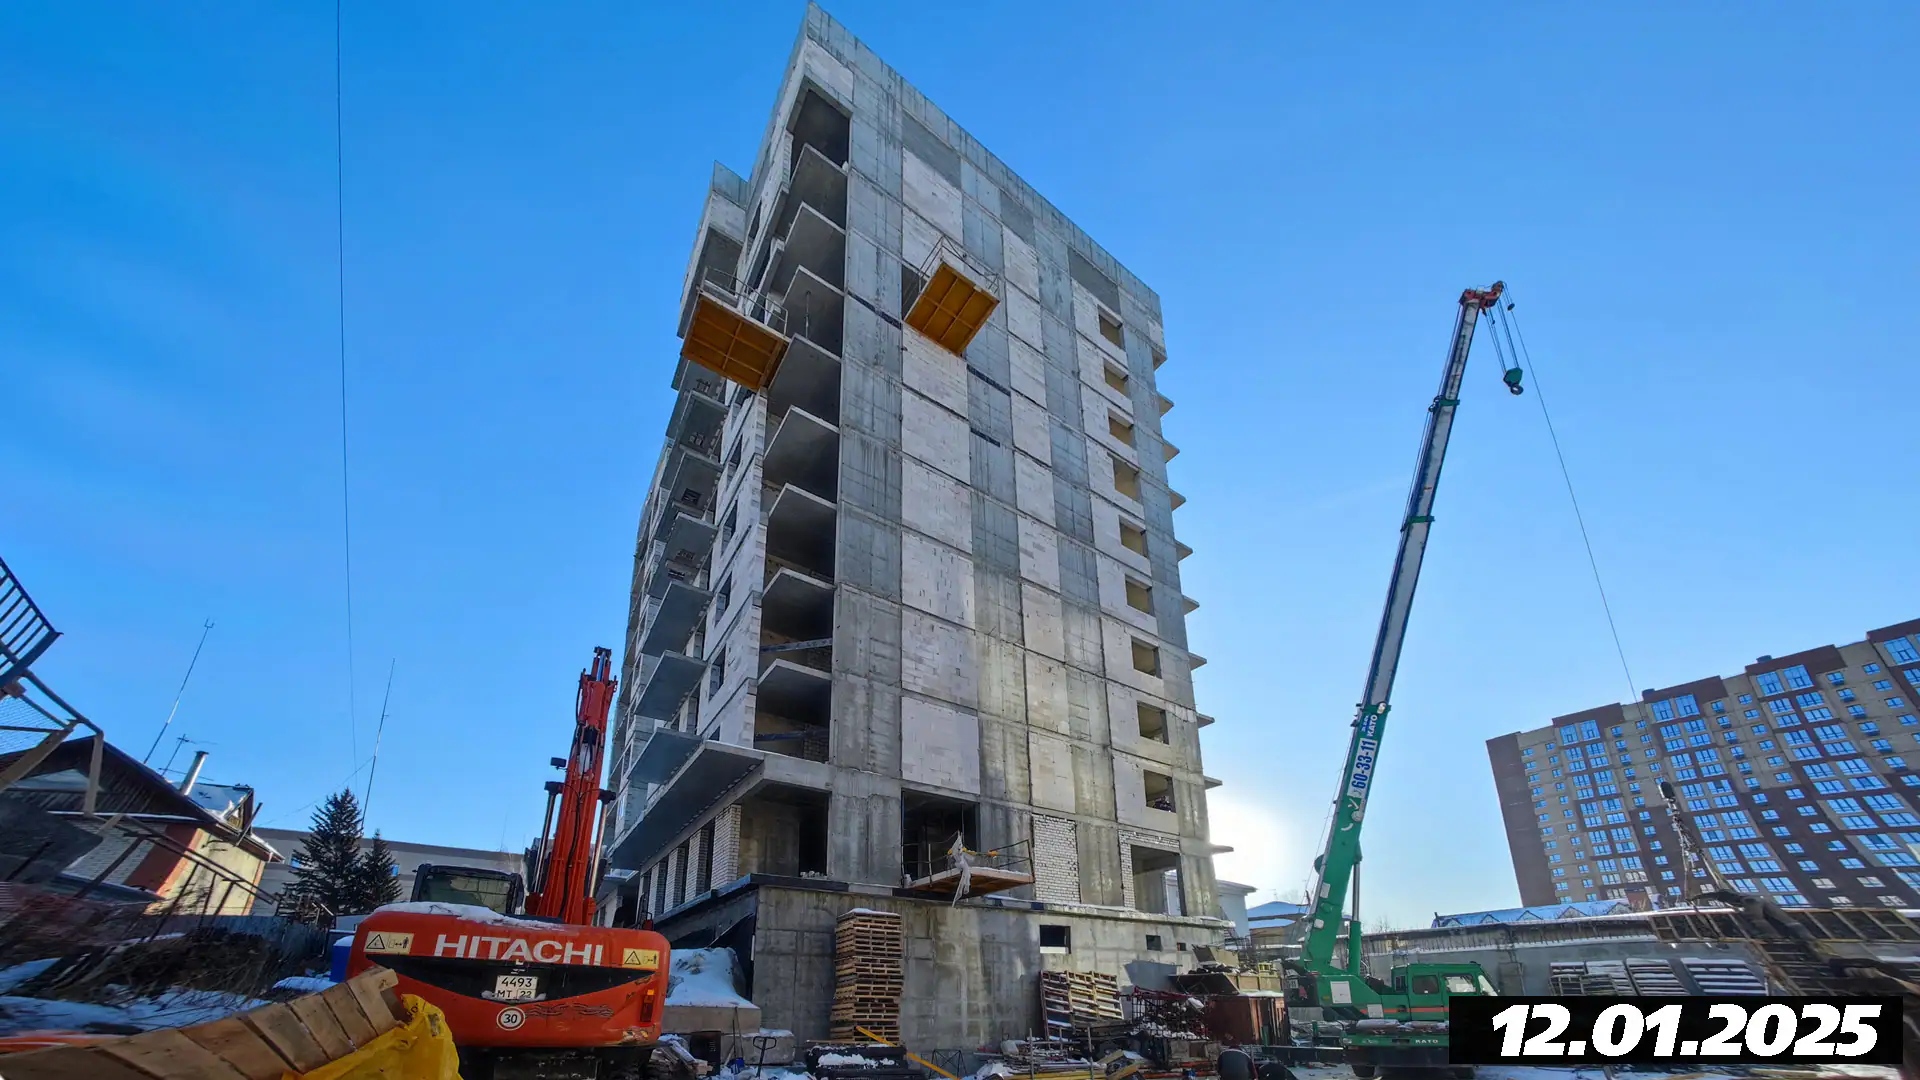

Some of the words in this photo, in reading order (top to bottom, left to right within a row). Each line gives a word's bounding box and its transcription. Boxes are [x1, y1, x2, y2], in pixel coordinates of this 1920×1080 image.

[1367, 714, 1378, 737] KATO
[1351, 740, 1376, 789] 60-33-11
[434, 934, 603, 966] HITACHI
[501, 977, 532, 988] 4493
[503, 1014, 517, 1024] 30
